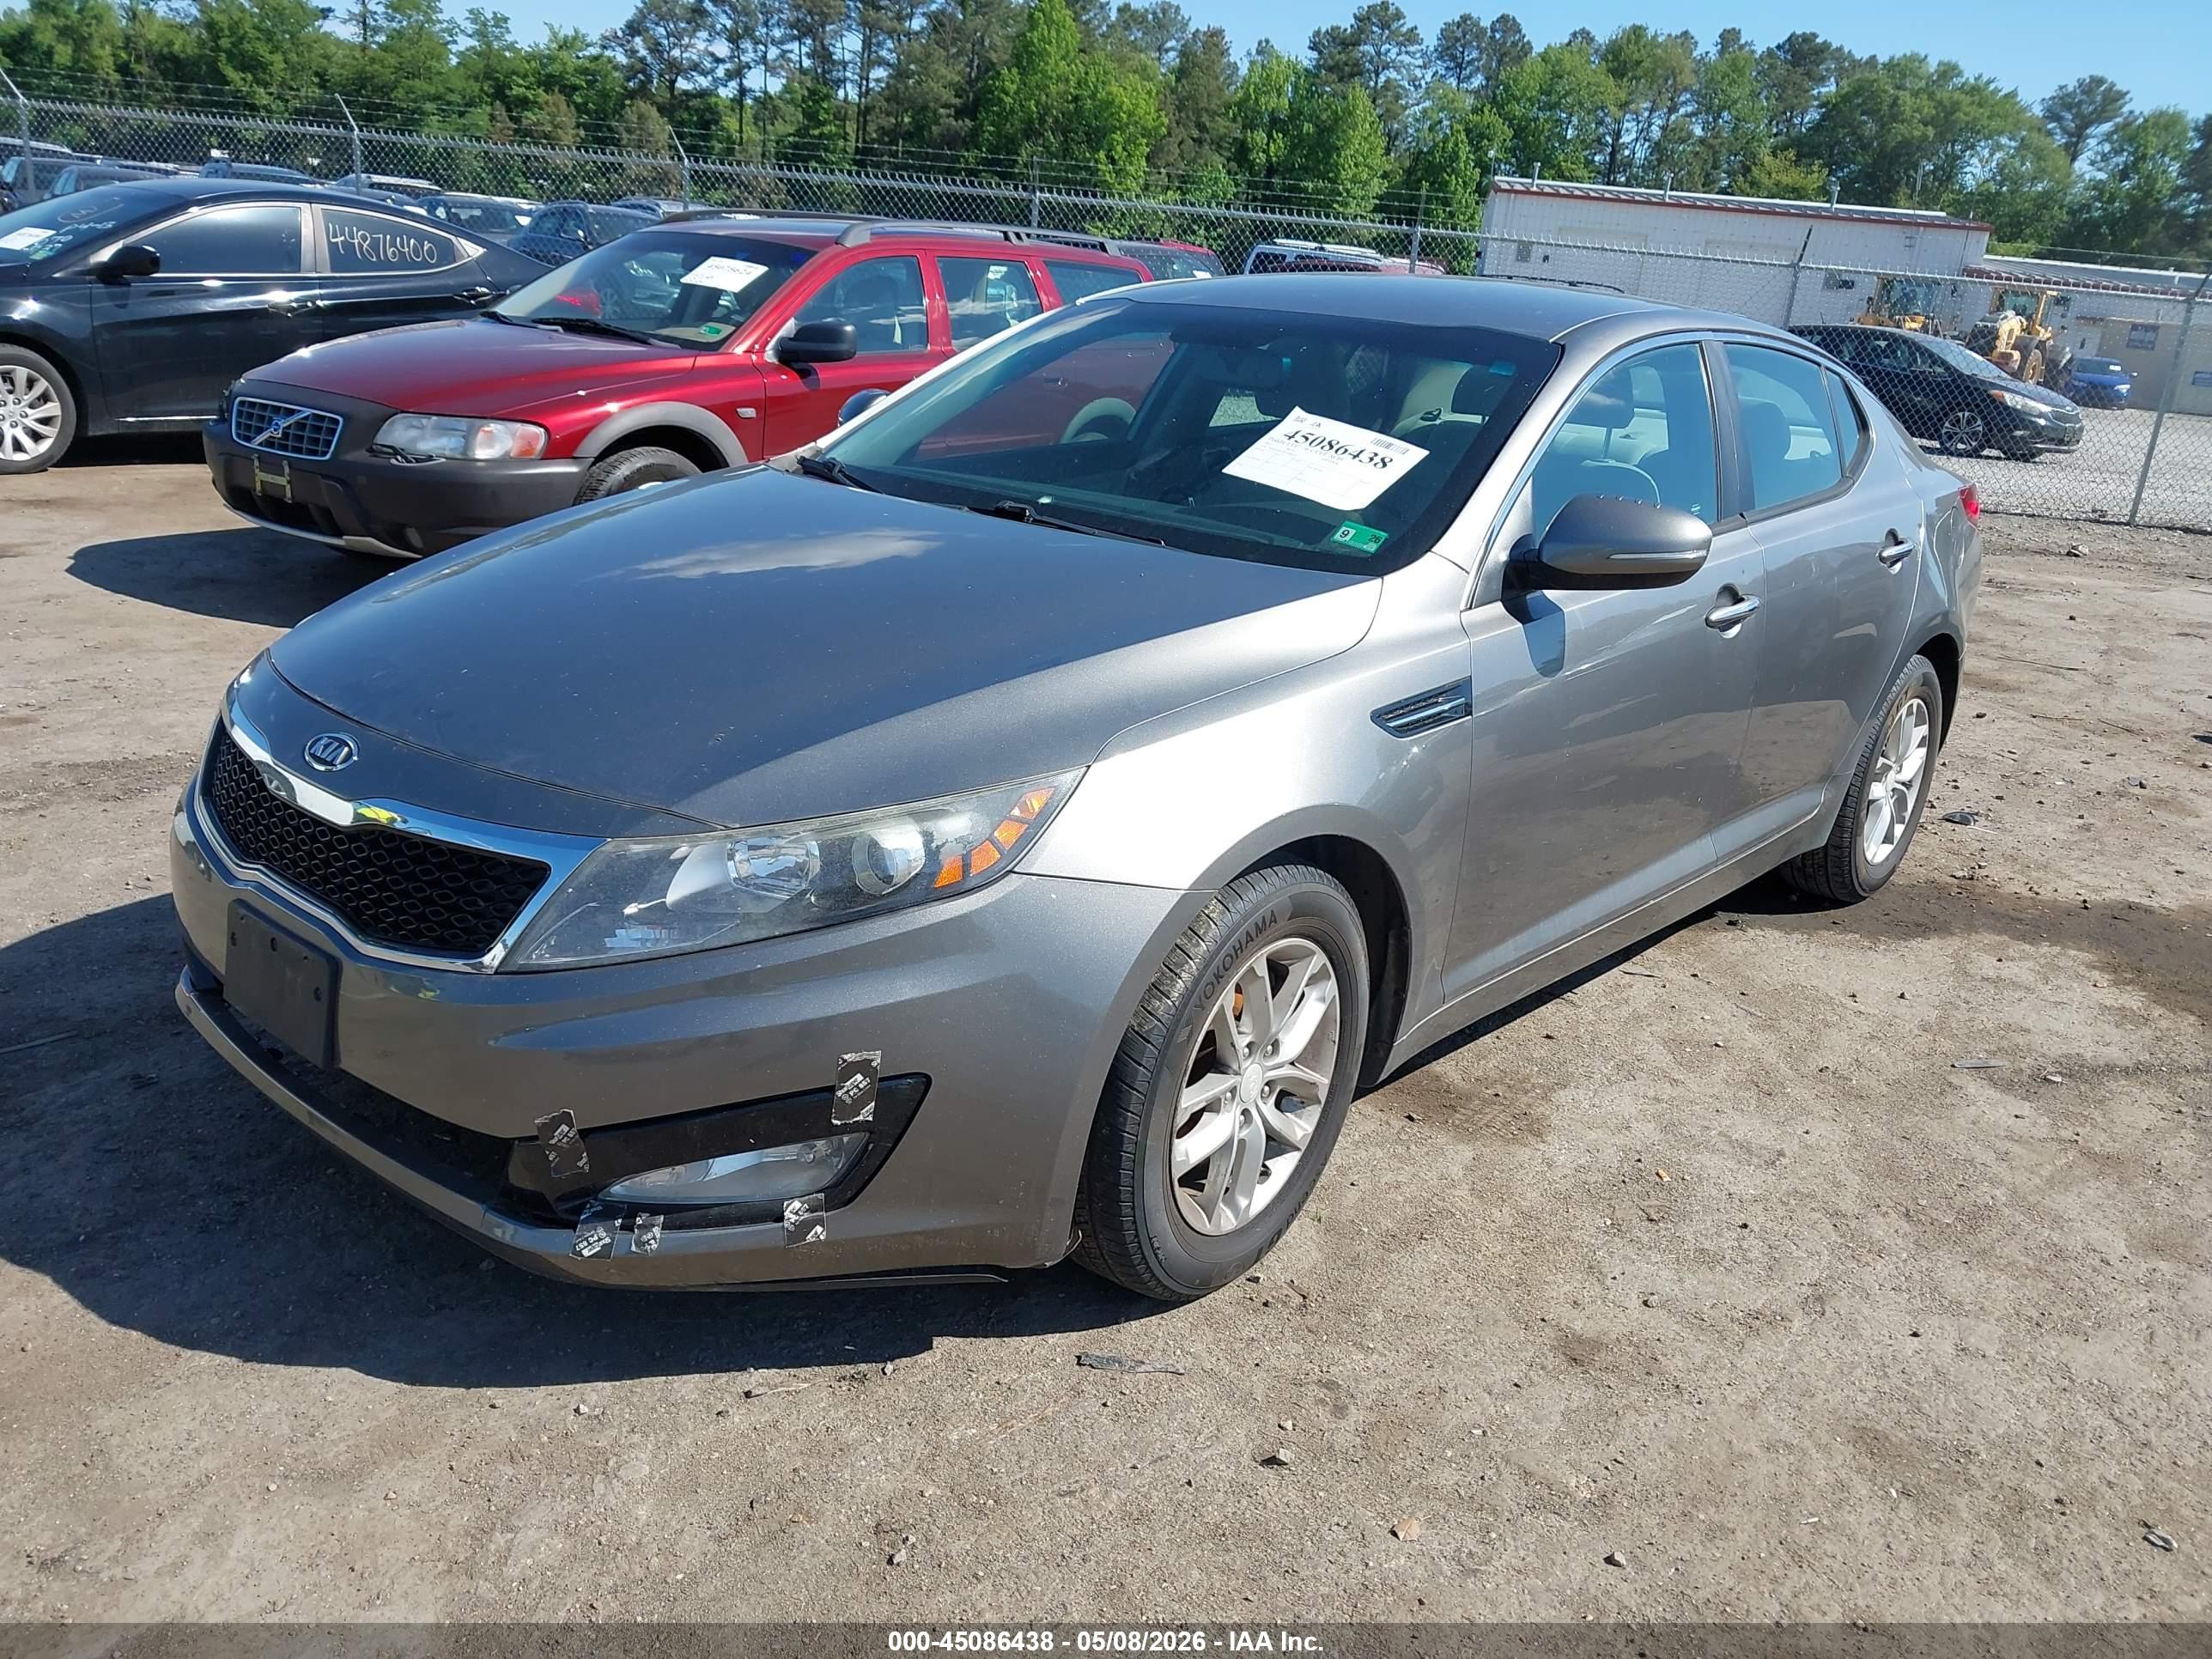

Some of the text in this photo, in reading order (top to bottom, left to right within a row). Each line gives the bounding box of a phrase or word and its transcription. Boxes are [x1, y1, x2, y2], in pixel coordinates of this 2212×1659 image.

[328, 222, 438, 264] 44876400
[1284, 429, 1394, 470] 45086438
[1340, 529, 1350, 538] 9
[1368, 534, 1382, 544] 26
[1194, 908, 1279, 1012] YOKOHAMA
